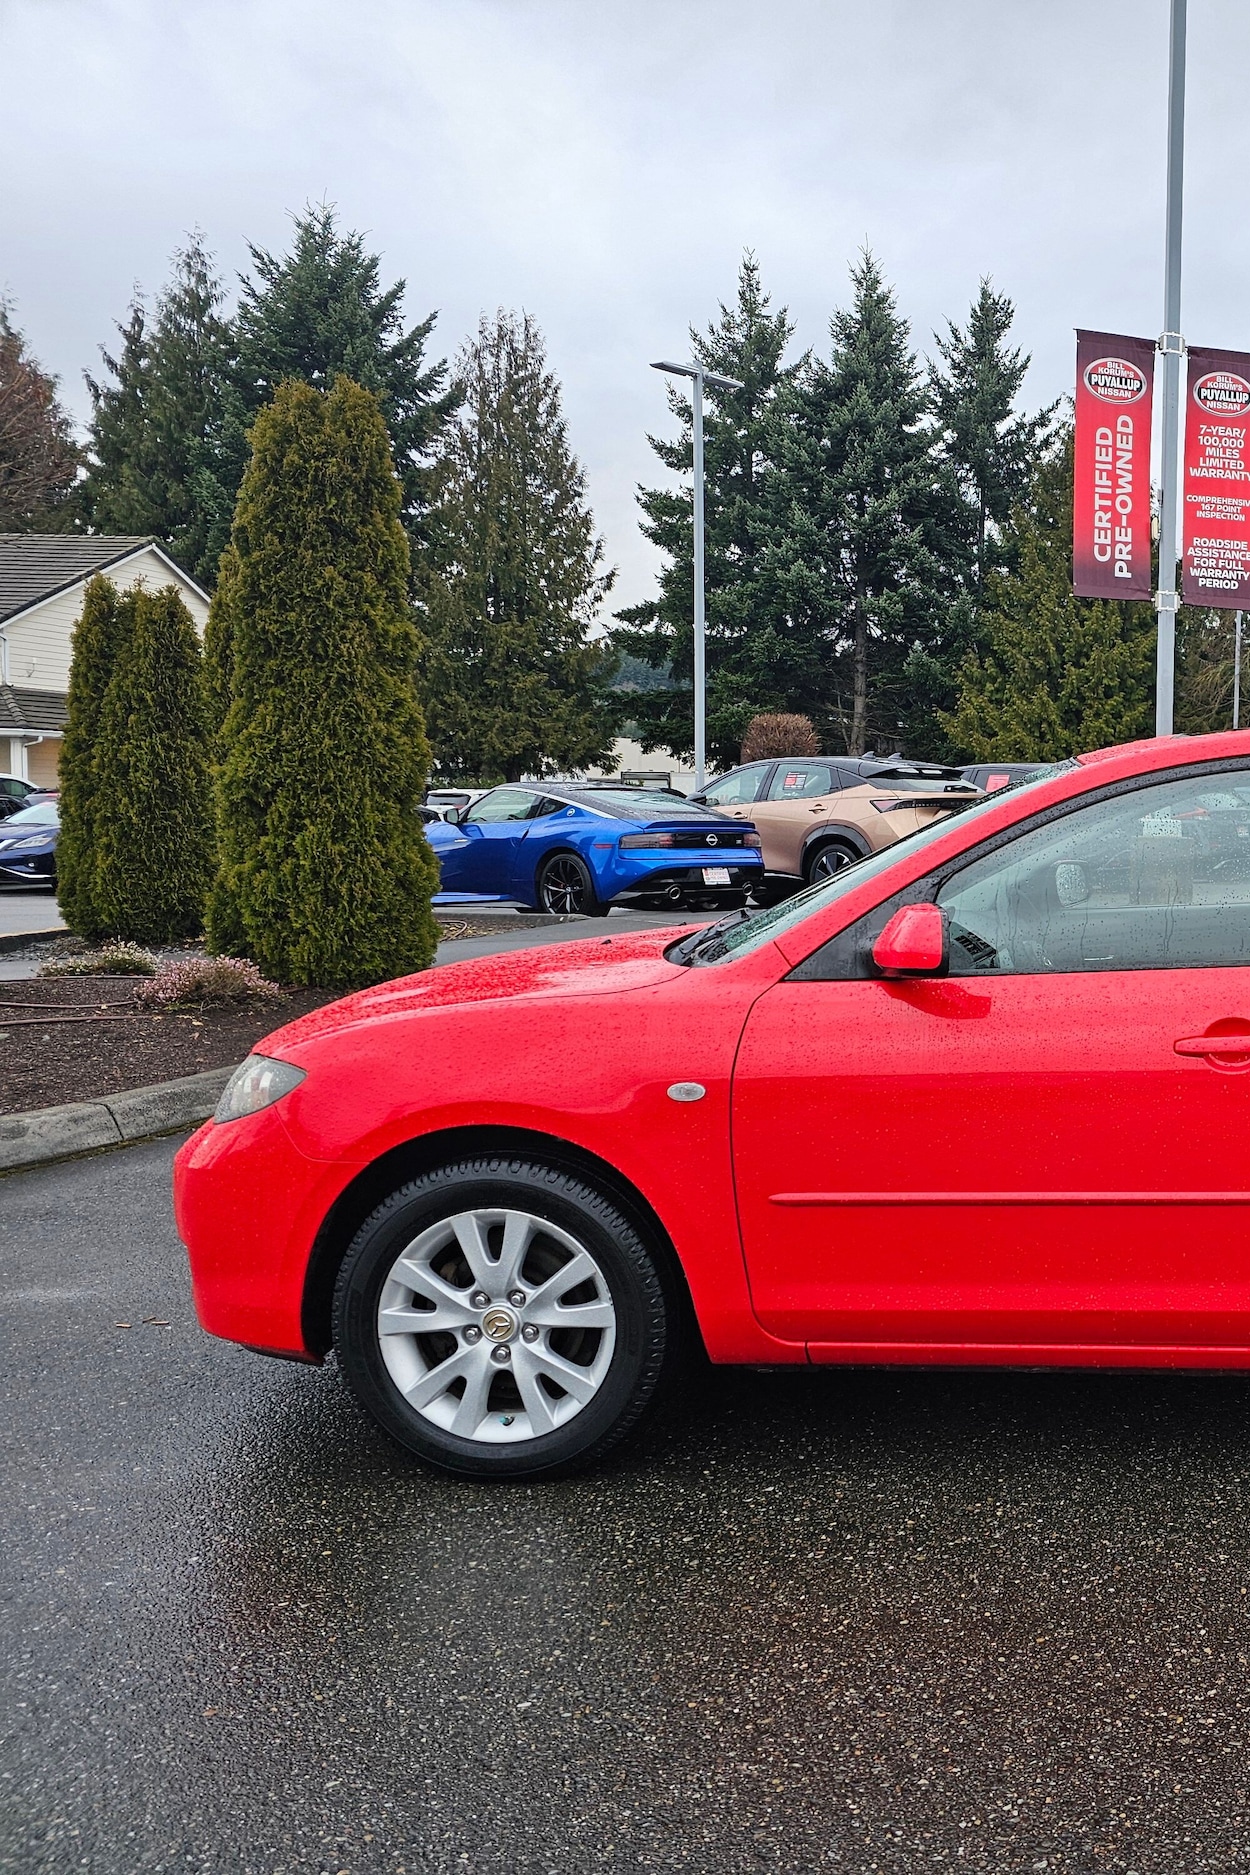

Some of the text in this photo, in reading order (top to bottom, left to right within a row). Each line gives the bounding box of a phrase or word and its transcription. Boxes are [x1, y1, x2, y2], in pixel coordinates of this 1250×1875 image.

[1098, 366, 1135, 378] KORUM'S
[1107, 361, 1125, 370] BILL
[1091, 373, 1141, 391] PUYALLUP
[1207, 381, 1243, 391] KORUM'S
[1216, 375, 1234, 384] BILL
[1097, 386, 1132, 399] NISSAN
[1200, 387, 1250, 404] PUYALLUP
[1206, 400, 1241, 411] NISSAN
[1199, 424, 1247, 439] 7-YEAR/
[1197, 435, 1245, 449] 100,000
[1205, 446, 1240, 459] MILES
[1199, 456, 1245, 470] LIMITED
[1093, 426, 1113, 563] CERTIFIED
[1114, 414, 1134, 579] PRE-OWNED
[1201, 503, 1242, 513] 167 POINT
[1196, 510, 1246, 522] INSPECTION
[1193, 536, 1248, 551] ROADSIDE
[1193, 557, 1245, 571] FOR FULL
[1189, 566, 1250, 581] WARRANTY
[1198, 577, 1239, 590] PERIOD
